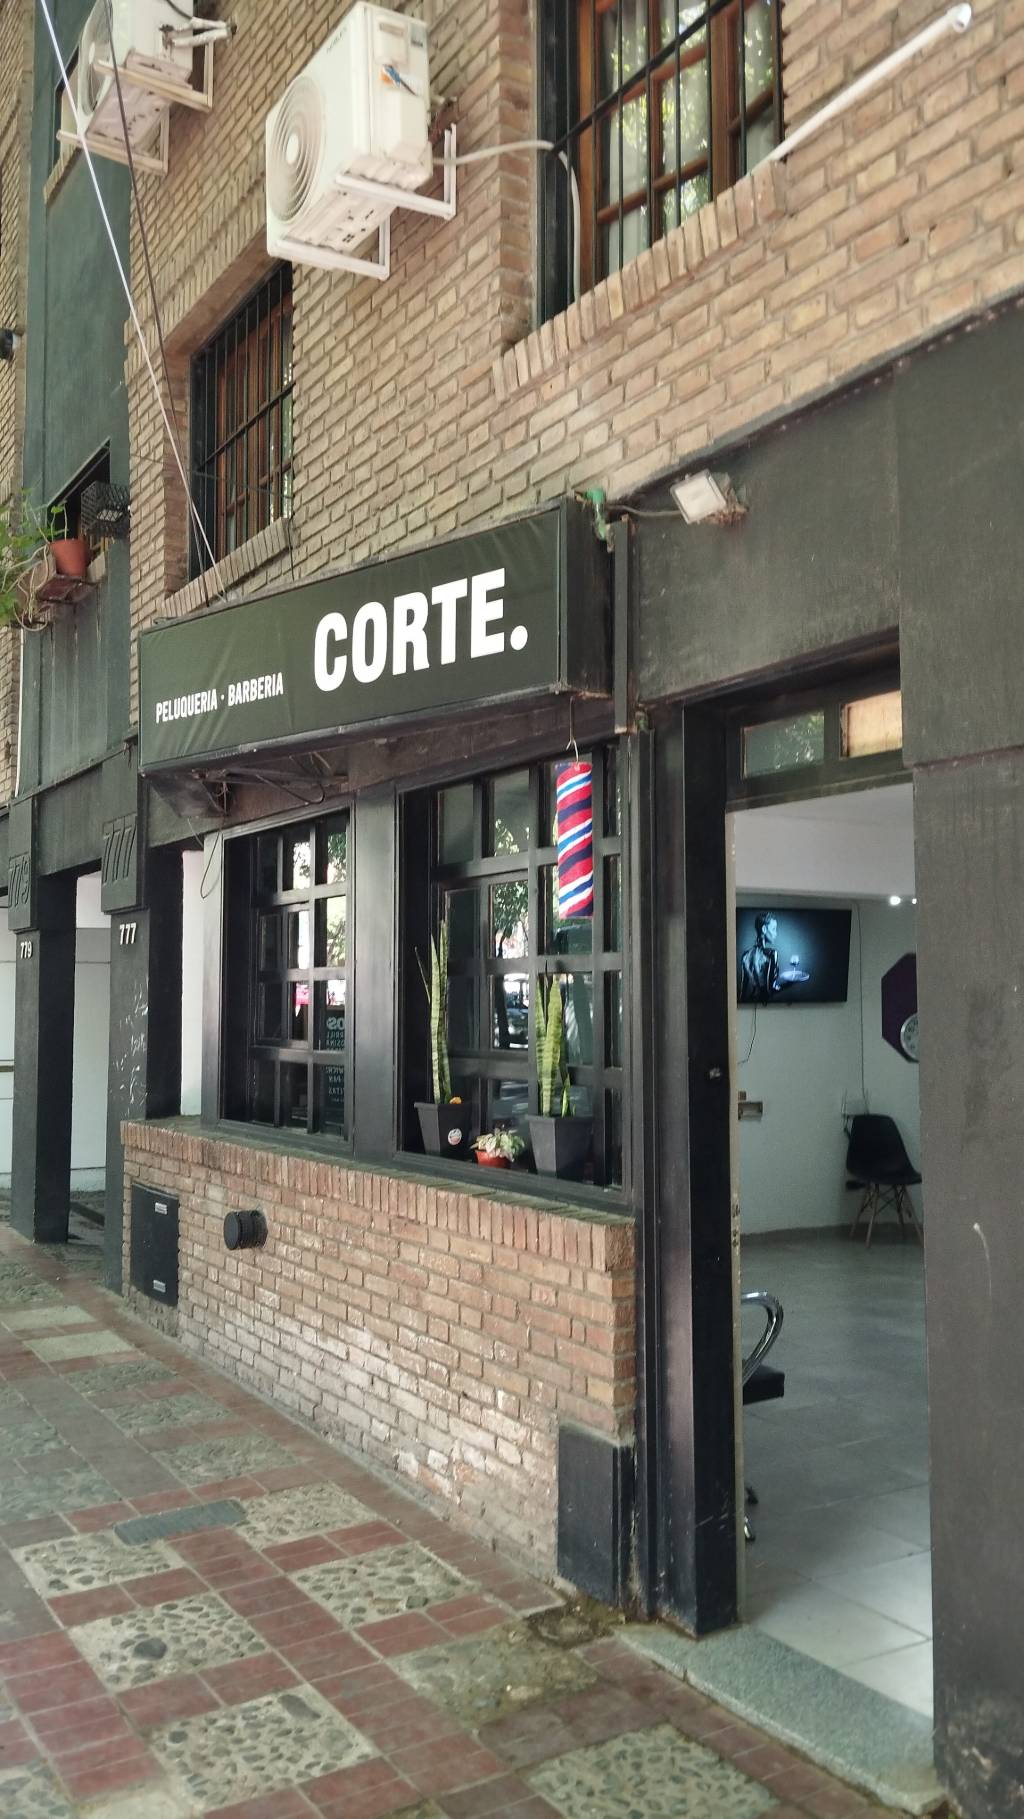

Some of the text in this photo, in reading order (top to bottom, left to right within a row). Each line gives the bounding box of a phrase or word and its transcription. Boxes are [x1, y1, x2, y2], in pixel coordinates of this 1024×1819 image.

[314, 567, 528, 692] CORTE.
[156, 689, 218, 723] PELUQUERIA
[228, 672, 284, 707] BARBERIA
[20, 941, 33, 960] 779
[119, 922, 137, 945] 777
